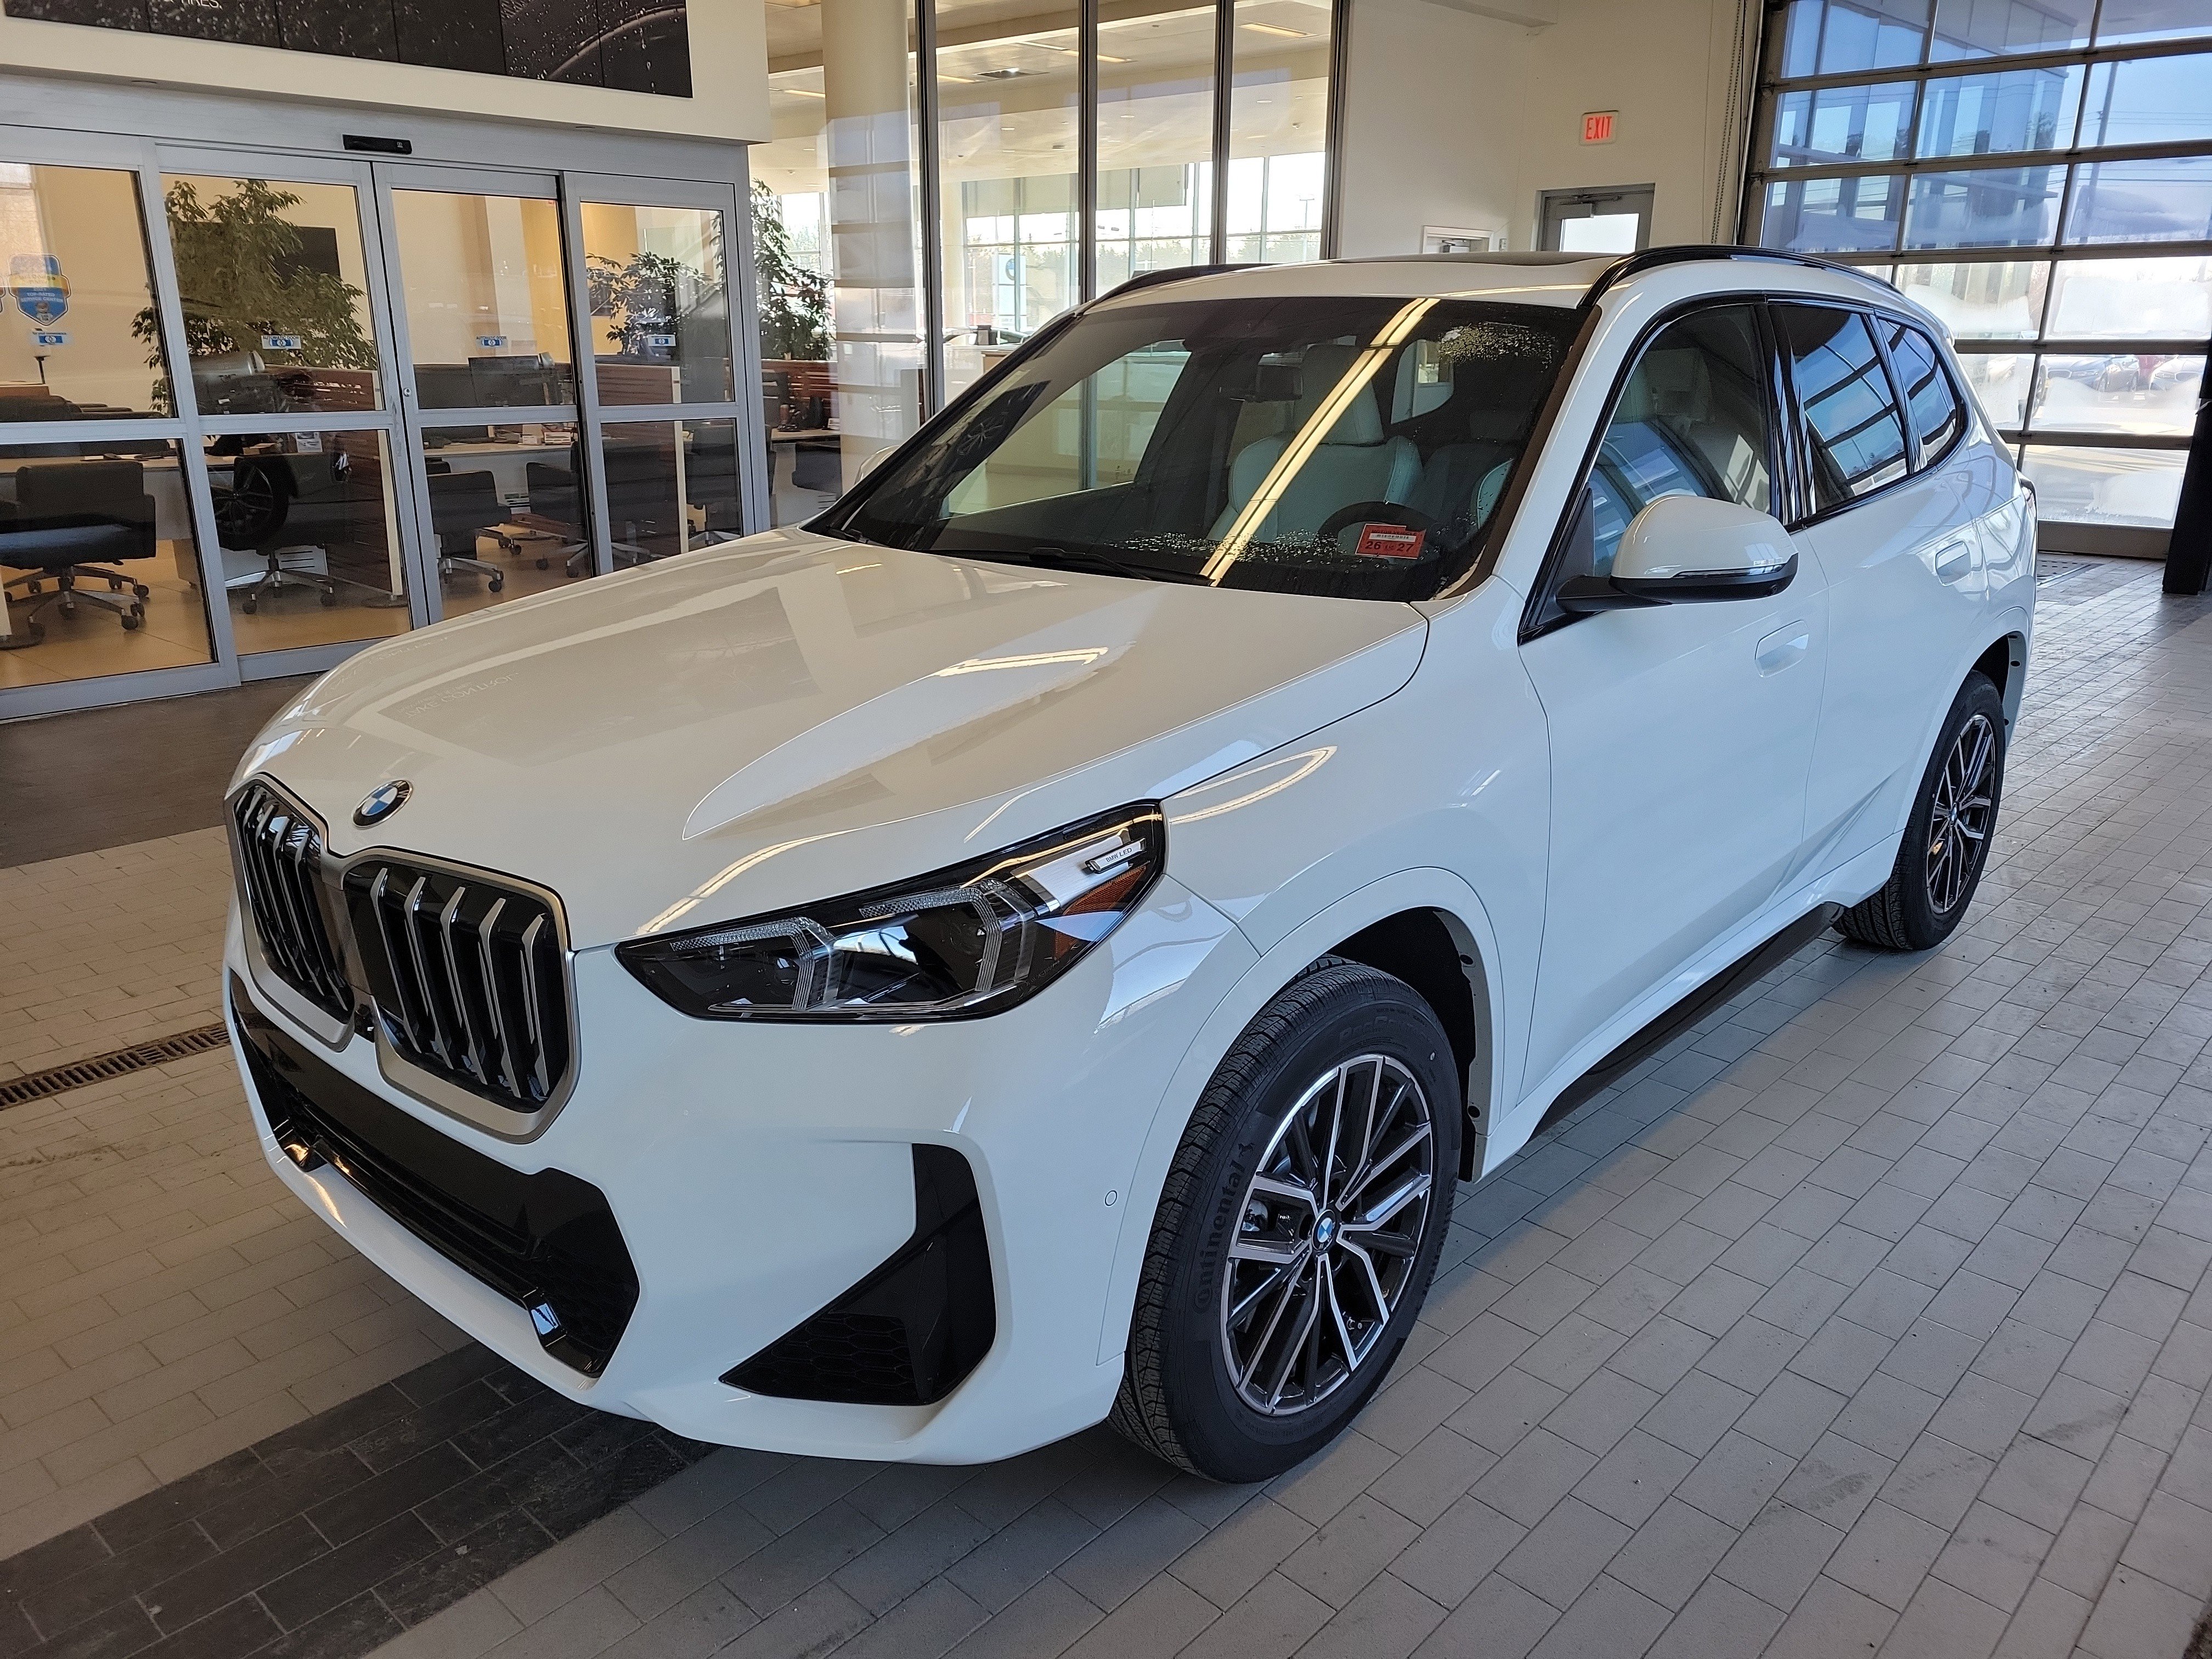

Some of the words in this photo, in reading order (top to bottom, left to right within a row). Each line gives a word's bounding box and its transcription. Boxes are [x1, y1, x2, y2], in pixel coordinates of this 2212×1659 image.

[181, 0, 223, 10] ES.
[1585, 116, 1612, 139] EXIT
[1364, 540, 1383, 550] 26
[1396, 542, 1415, 552] 27
[1105, 853, 1119, 863] BMW
[1119, 848, 1132, 857] LED
[1192, 1159, 1246, 1314] Continental
